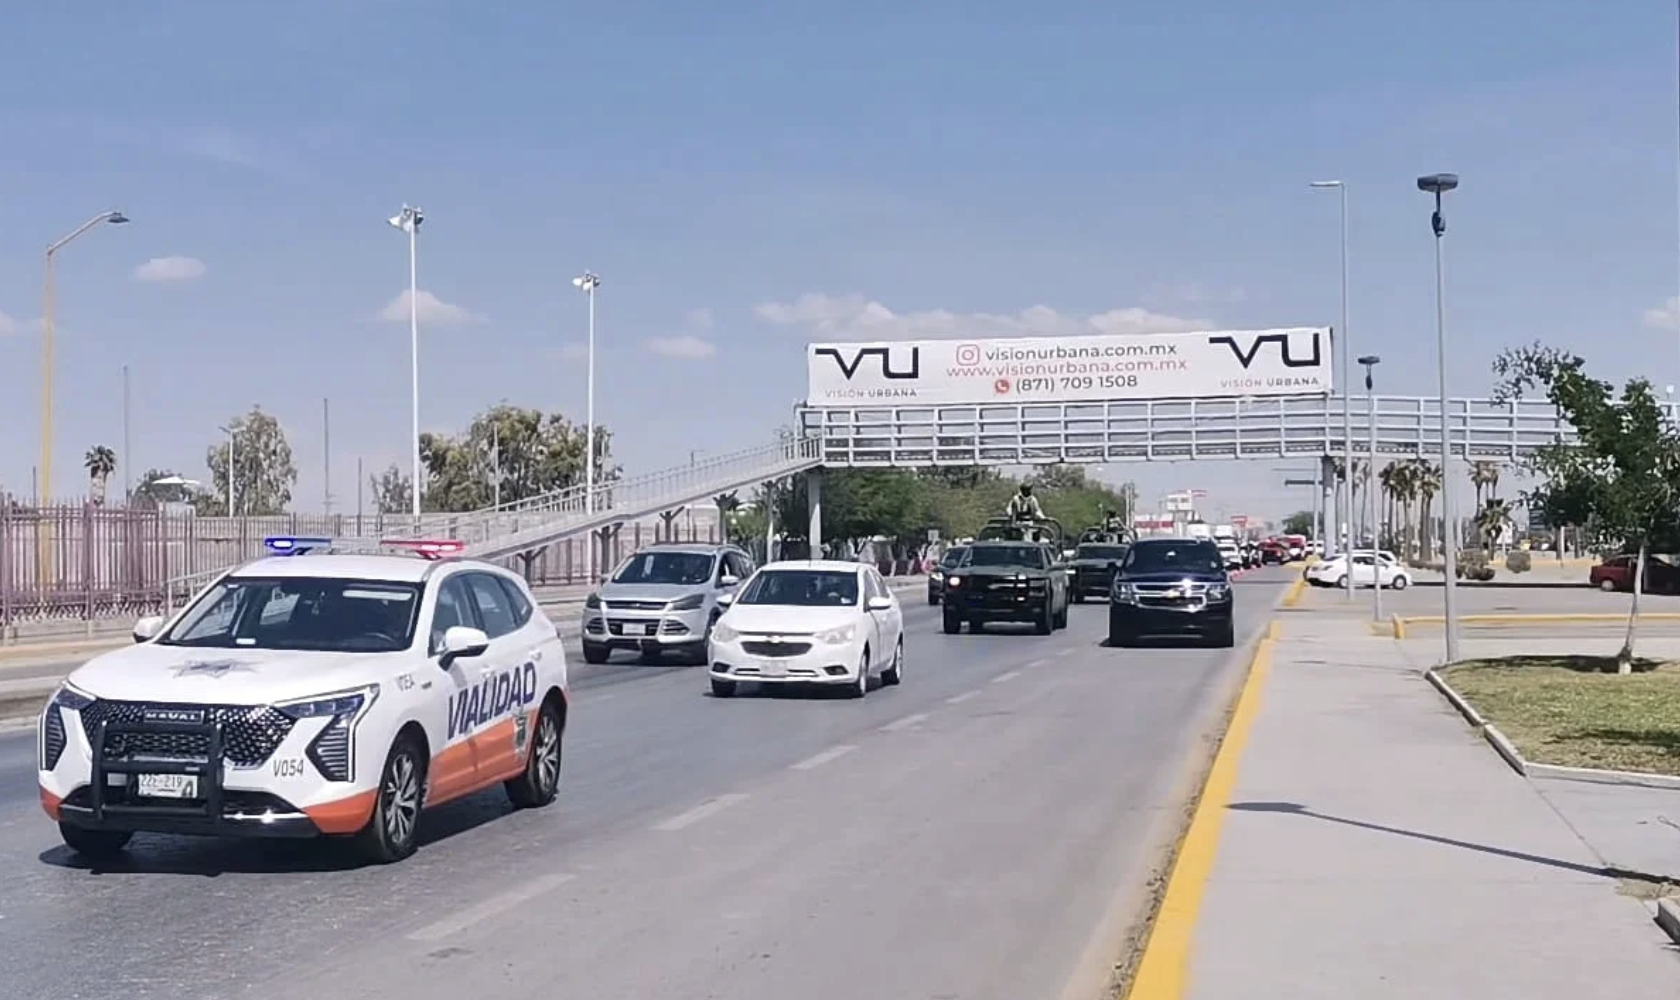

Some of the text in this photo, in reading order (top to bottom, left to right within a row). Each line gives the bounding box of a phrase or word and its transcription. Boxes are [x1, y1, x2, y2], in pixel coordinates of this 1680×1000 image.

[985, 345, 1178, 360] visionurbana.com.mx
[1208, 332, 1320, 369] VU
[815, 346, 919, 380] VU
[946, 359, 1188, 377] www.visionurbana.com.mx
[1016, 374, 1138, 395] (871) 709 1508
[1266, 376, 1320, 388] URBANA
[868, 387, 918, 398] URBANA
[448, 661, 537, 741] VIALIDAD
[273, 758, 304, 777] V054
